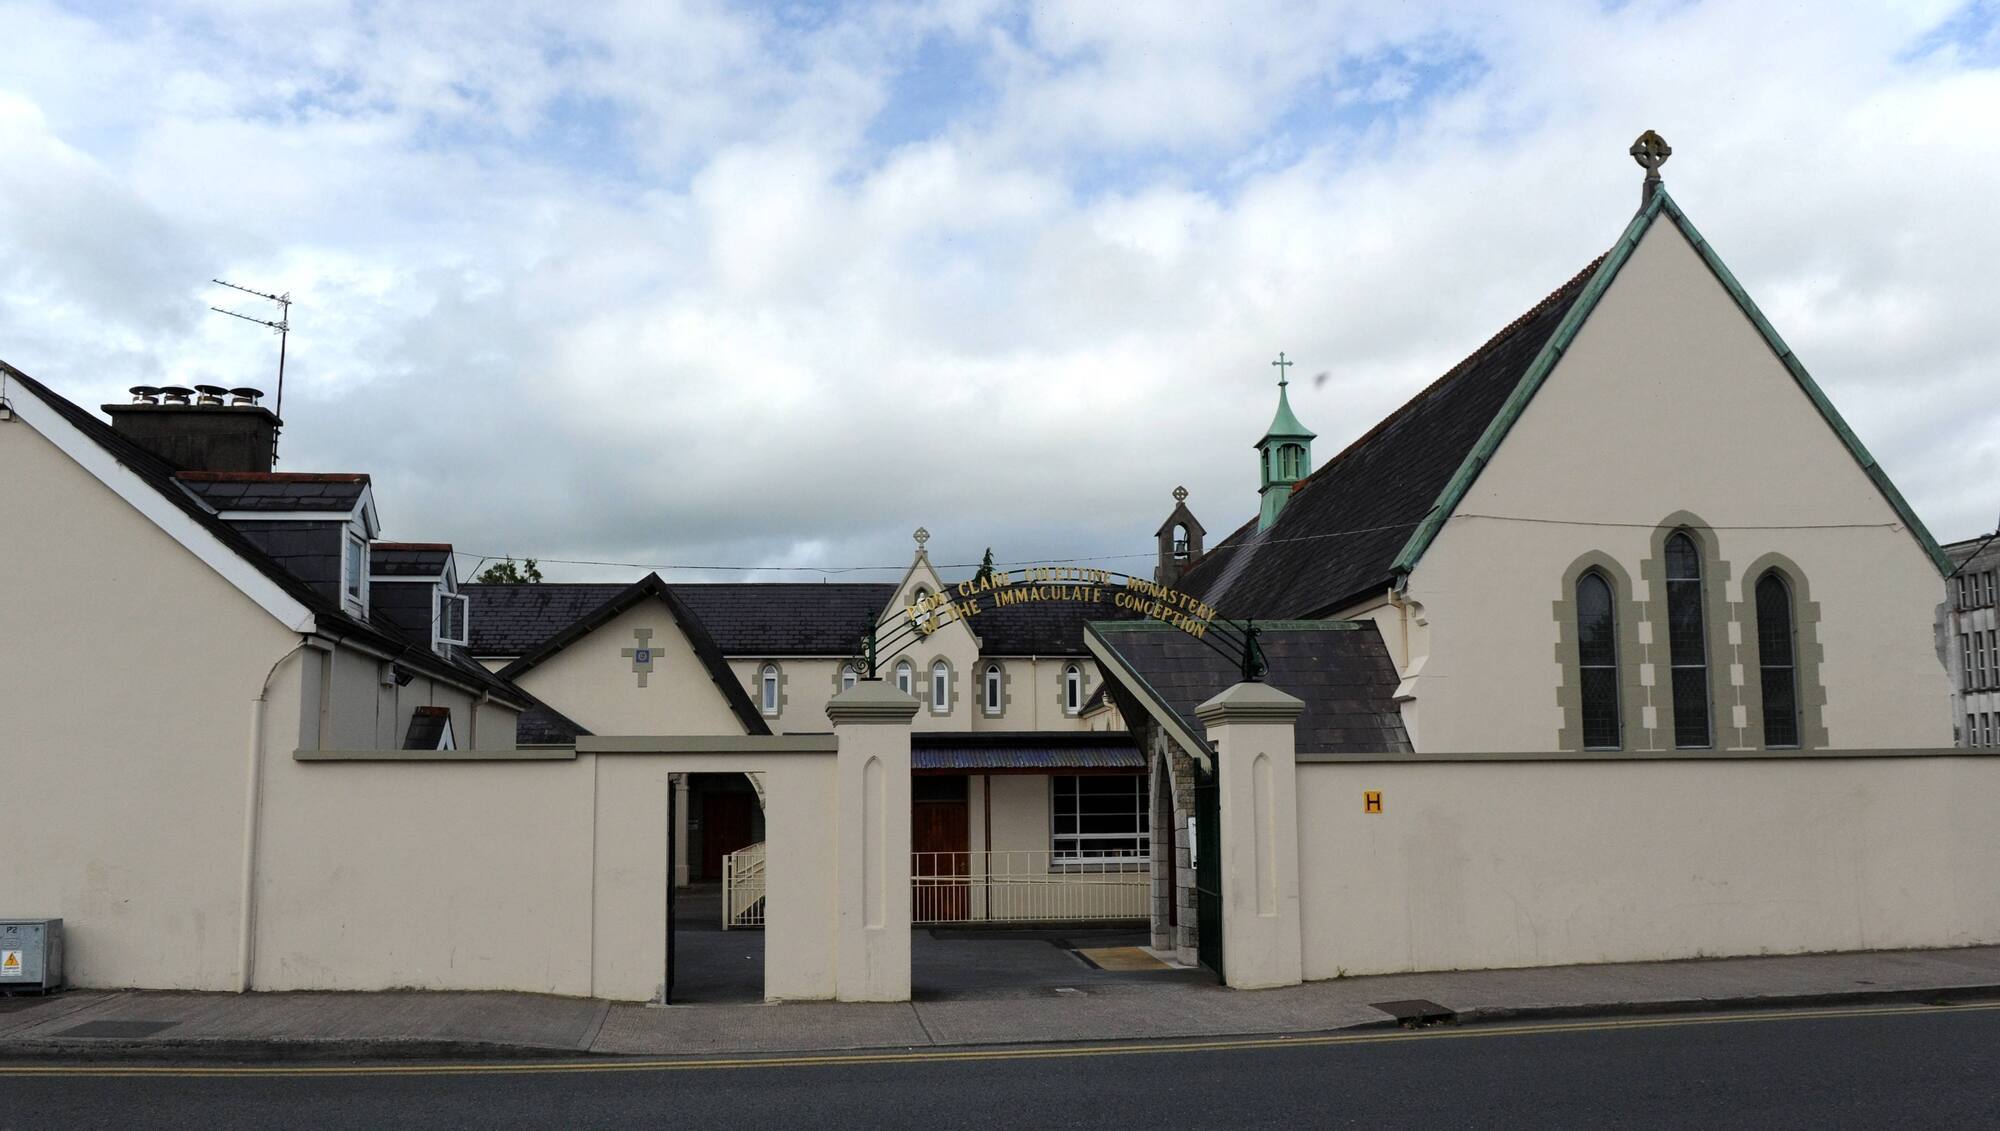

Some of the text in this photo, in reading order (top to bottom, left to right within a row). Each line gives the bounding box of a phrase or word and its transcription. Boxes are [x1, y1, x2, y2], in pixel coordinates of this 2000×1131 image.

[946, 598, 981, 623] THE
[994, 585, 1102, 608] IMMACULATE
[1115, 592, 1206, 639] CONCEPTION
[959, 572, 1010, 596] CLARE
[1126, 576, 1216, 622] MONASTERY
[1366, 793, 1380, 811] H
